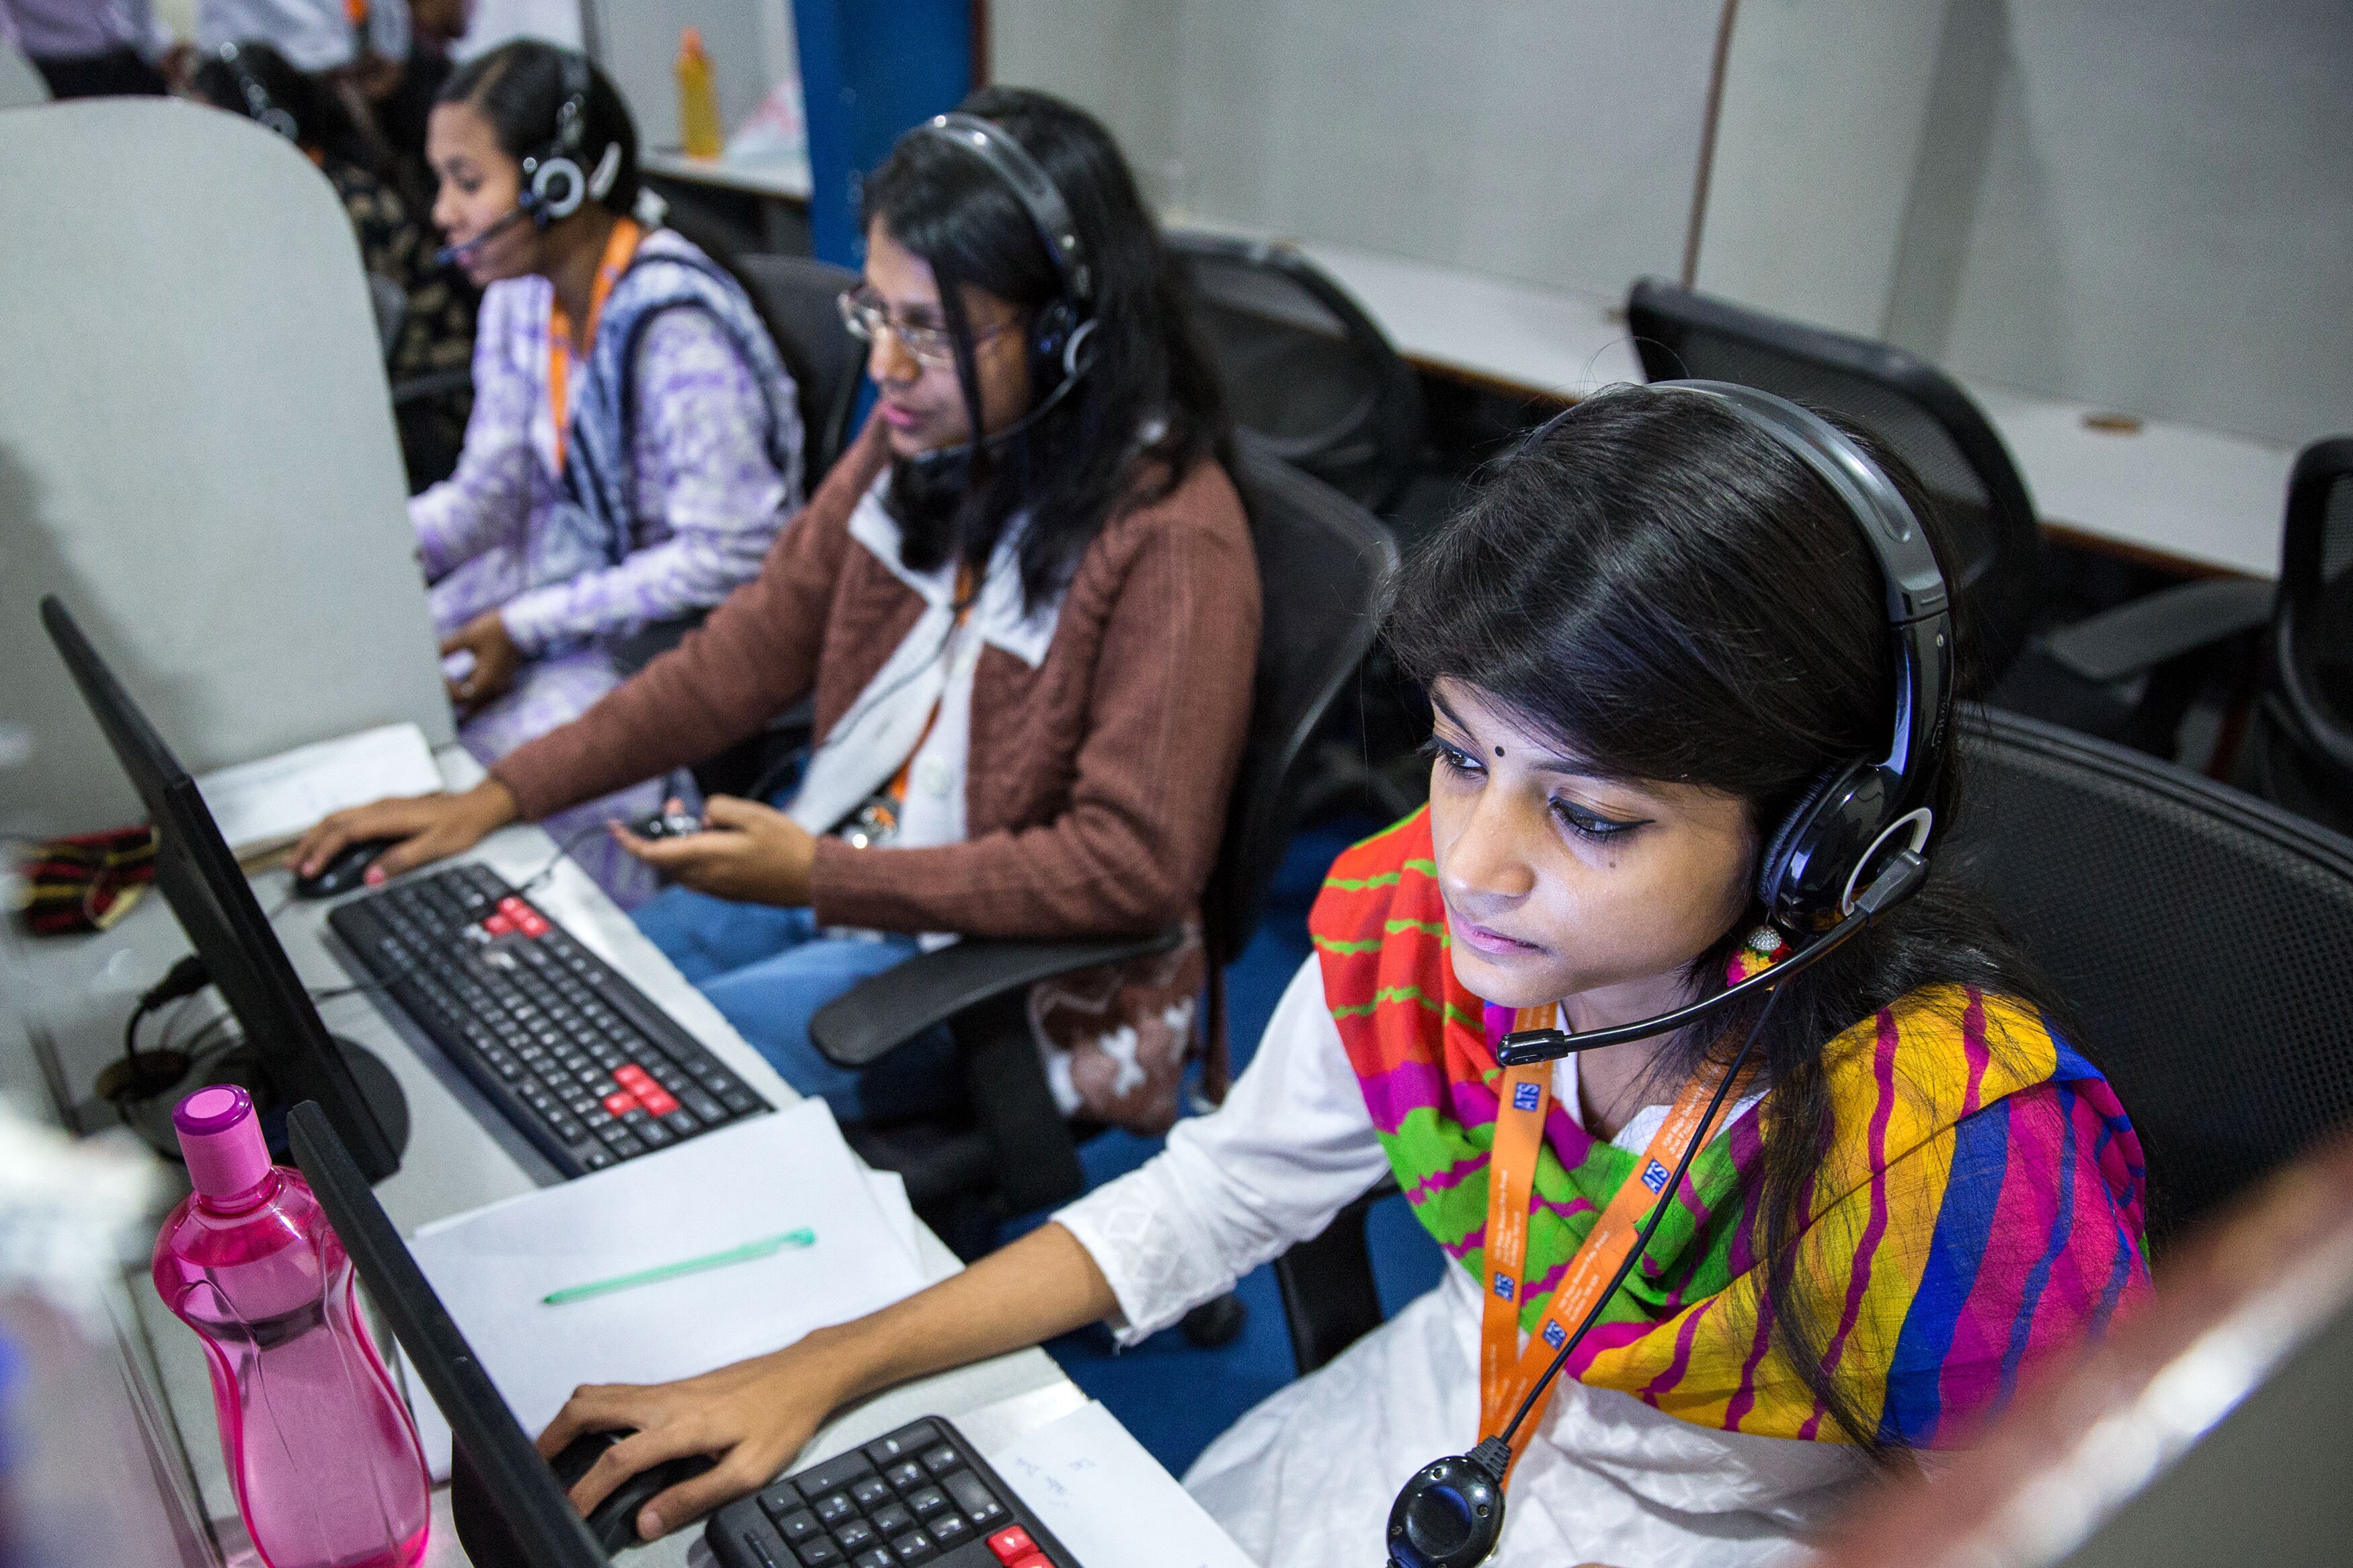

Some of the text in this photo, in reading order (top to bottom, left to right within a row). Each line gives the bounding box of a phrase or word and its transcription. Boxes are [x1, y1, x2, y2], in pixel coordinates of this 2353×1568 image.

[1515, 1083, 1539, 1111] ATS
[1642, 1161, 1669, 1194] ATS
[1494, 1273, 1513, 1301] ATS
[1544, 1321, 1566, 1349] ATS
